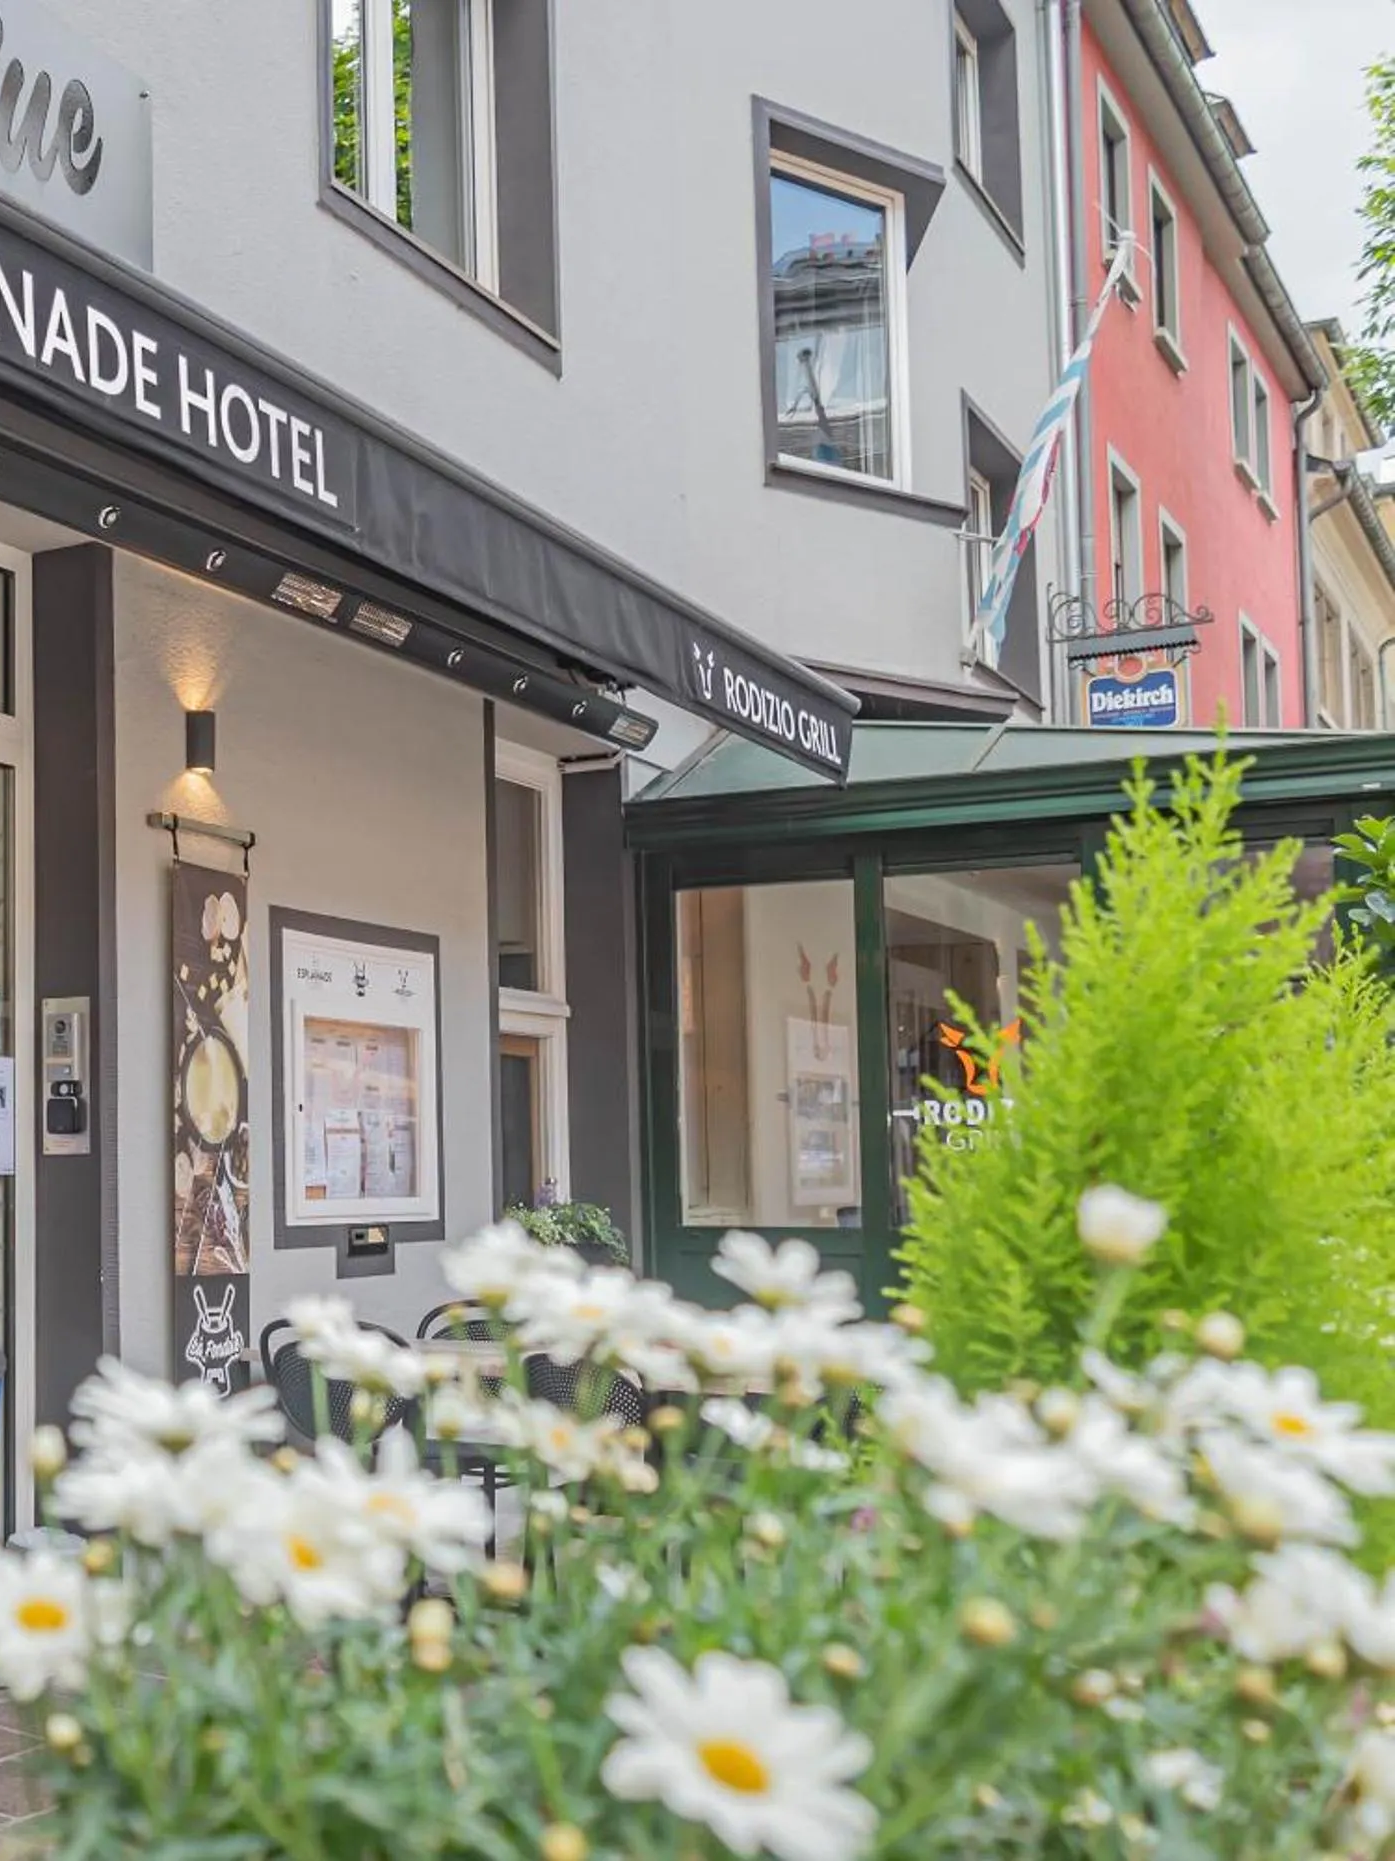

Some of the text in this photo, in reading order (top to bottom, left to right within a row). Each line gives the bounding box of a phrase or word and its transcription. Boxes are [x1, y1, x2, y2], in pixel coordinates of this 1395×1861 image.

[178, 353, 339, 508] HOTEL
[723, 667, 842, 764] RODIZIO GRILL
[1091, 683, 1174, 712] Diekirch
